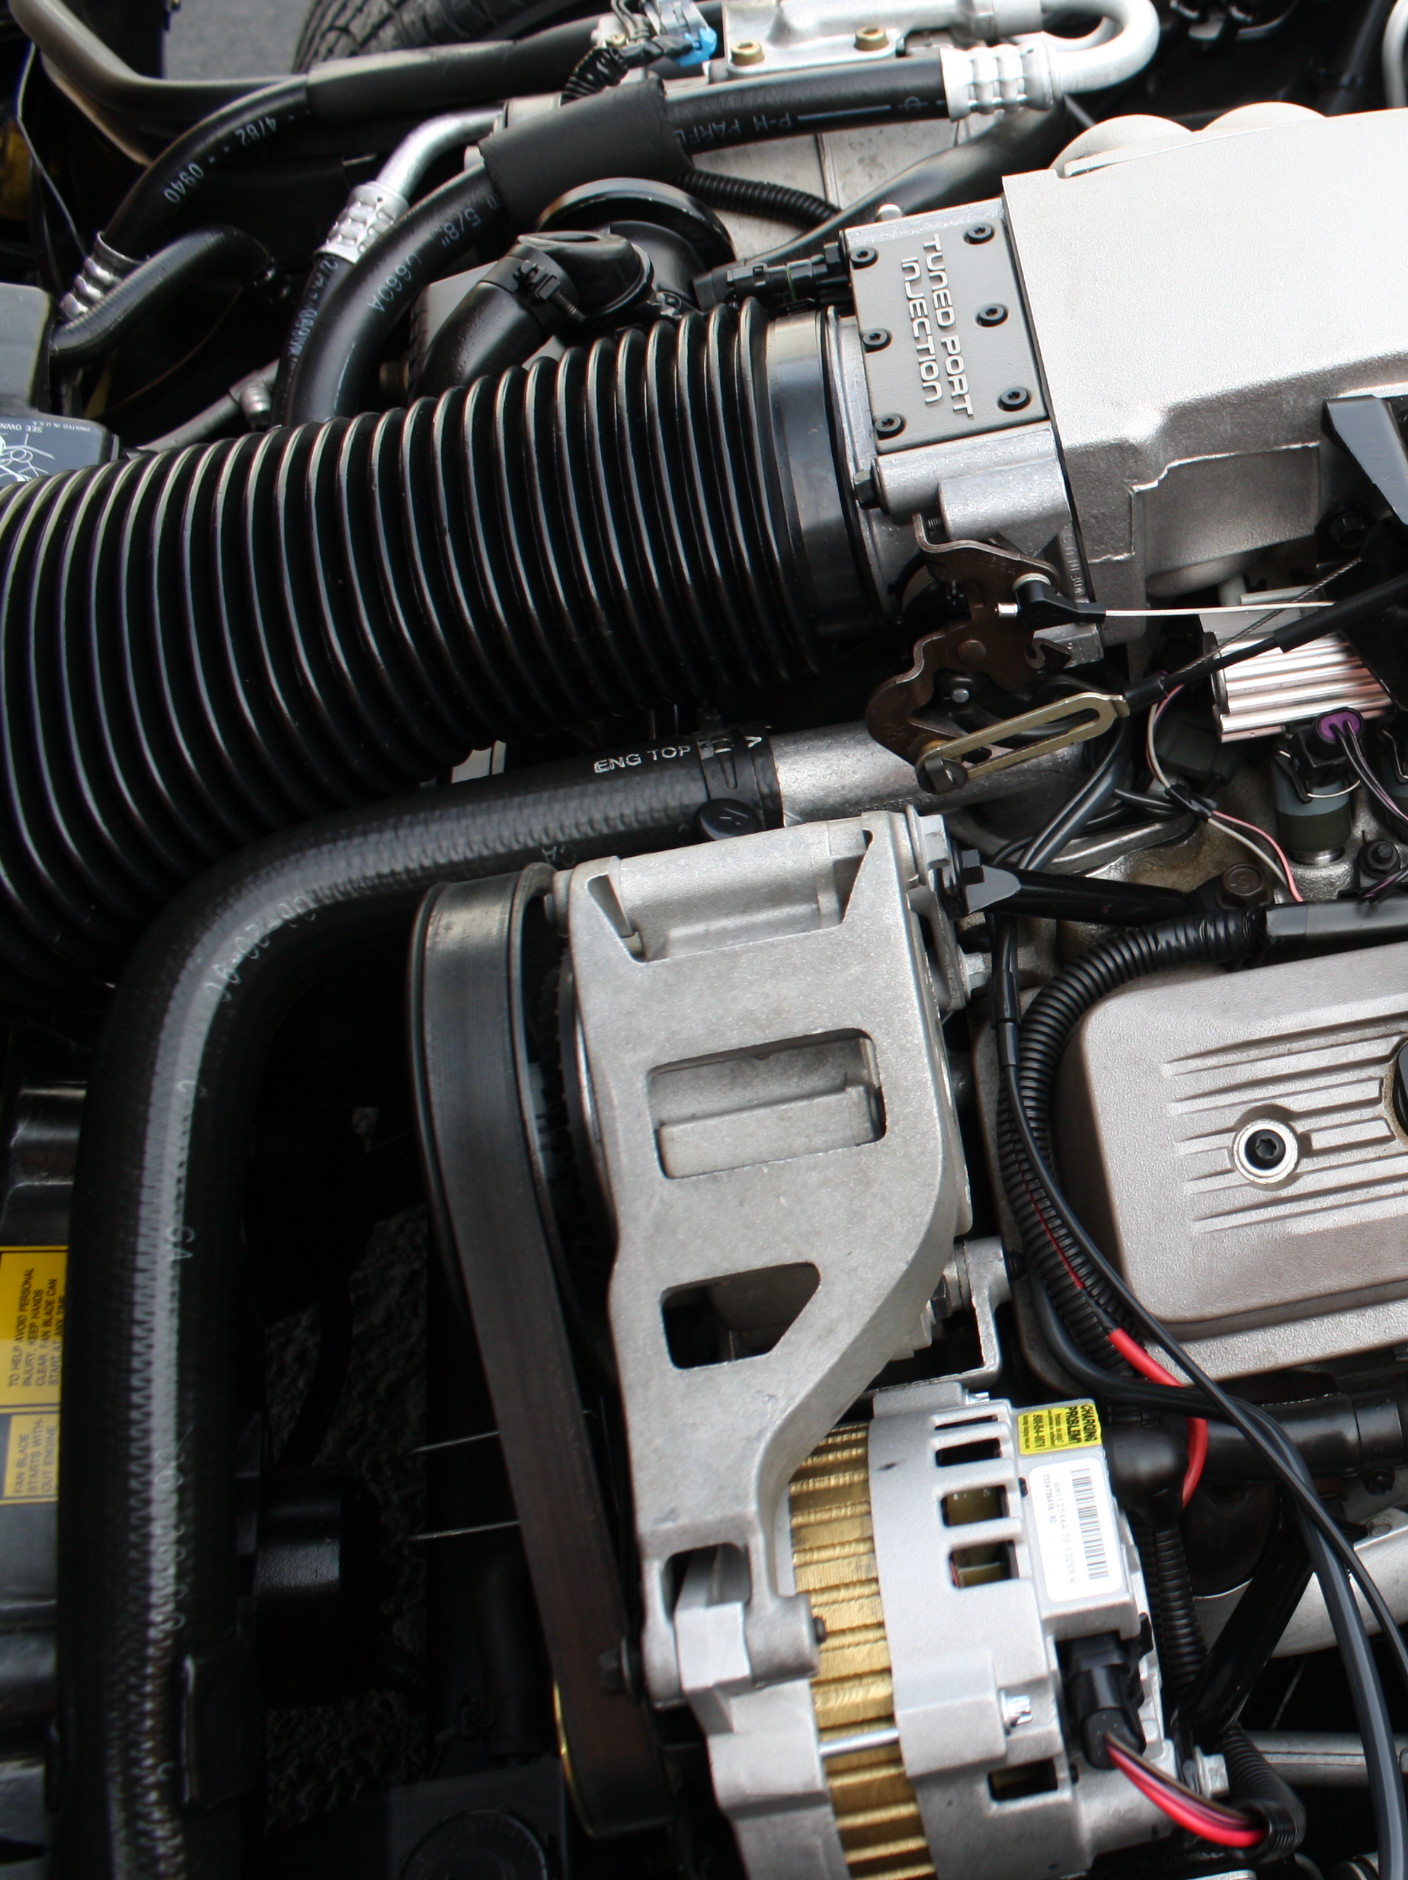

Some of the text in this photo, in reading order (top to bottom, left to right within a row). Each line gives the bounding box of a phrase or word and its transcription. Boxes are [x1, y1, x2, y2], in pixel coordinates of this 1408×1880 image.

[163, 161, 205, 205] 0940
[901, 256, 944, 405] INJECTION
[922, 233, 974, 419] TUNED PORT
[25, 424, 43, 434] SEE
[63, 423, 91, 432] PRINTED
[593, 744, 692, 774] ENG TOP
[46, 1278, 58, 1297] CAN
[31, 1289, 44, 1319] HANDS
[42, 1299, 56, 1328] BLADE
[7, 1268, 34, 1387] TO HELP AVOID PERSONAL
[27, 1321, 39, 1346] KEEP
[41, 1330, 52, 1349] FAN
[51, 1340, 63, 1353] AT
[48, 1355, 62, 1386] START
[1081, 1404, 1098, 1442] CHARGING
[14, 1433, 29, 1494] FAN BLADE
[28, 1451, 41, 1493] STARTS
[41, 1426, 57, 1493] OUT ENGINE
